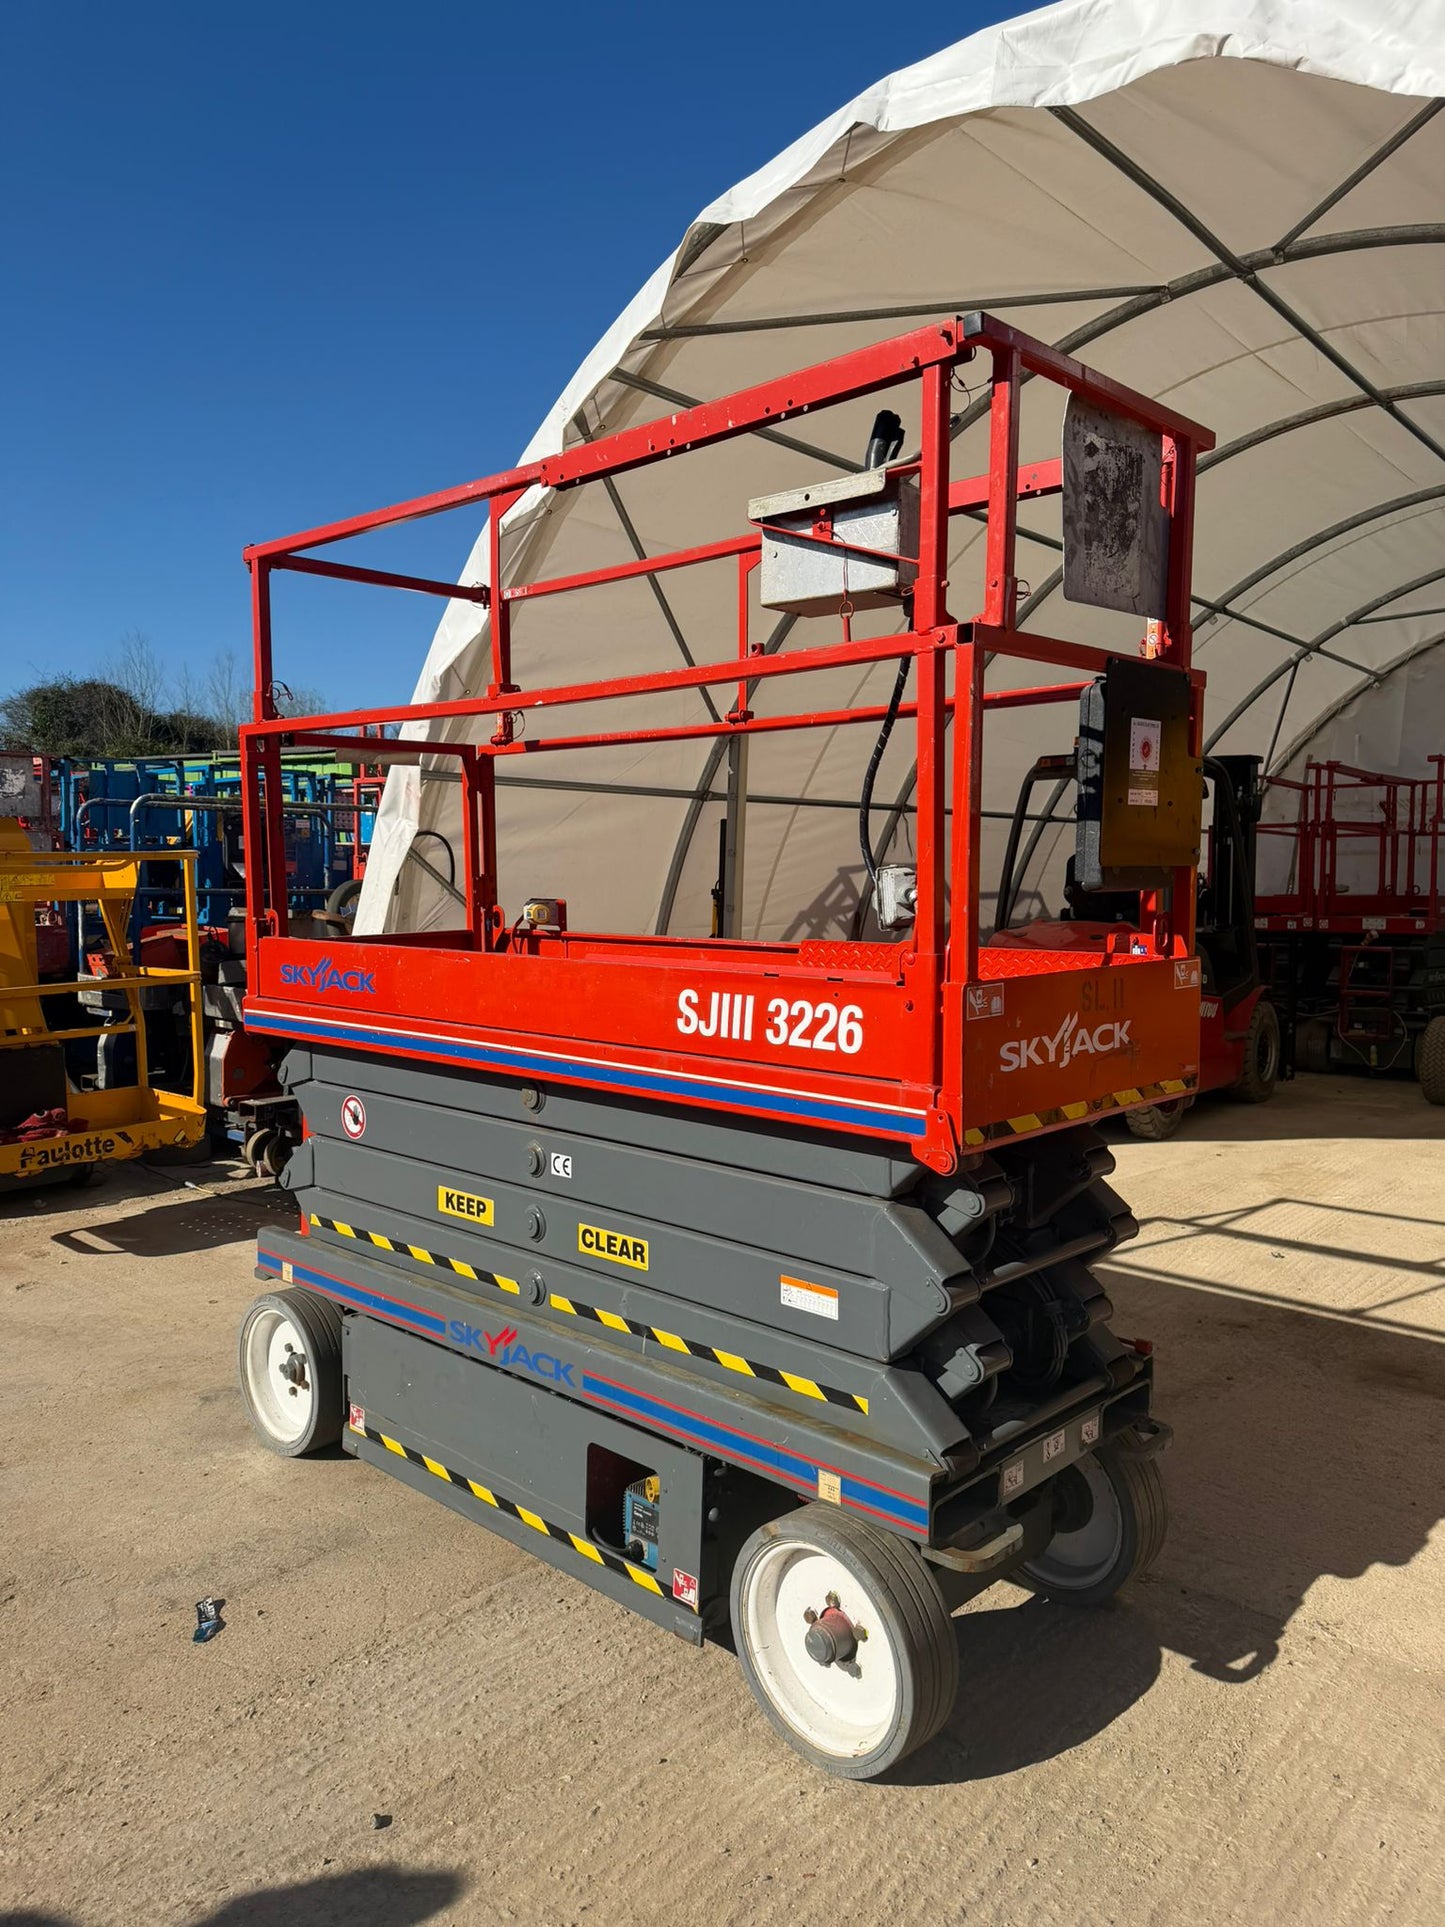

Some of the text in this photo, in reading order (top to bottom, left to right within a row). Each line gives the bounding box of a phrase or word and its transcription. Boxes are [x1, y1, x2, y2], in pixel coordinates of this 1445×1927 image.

[281, 957, 377, 994] SKYJACK
[676, 988, 864, 1054] SJIII 3226
[1000, 1011, 1132, 1072] SKYJACK
[552, 1155, 571, 1176] CE
[445, 1191, 487, 1218] KEEP
[581, 1228, 646, 1264] CLEAR
[449, 1320, 577, 1389] SKYJACK
